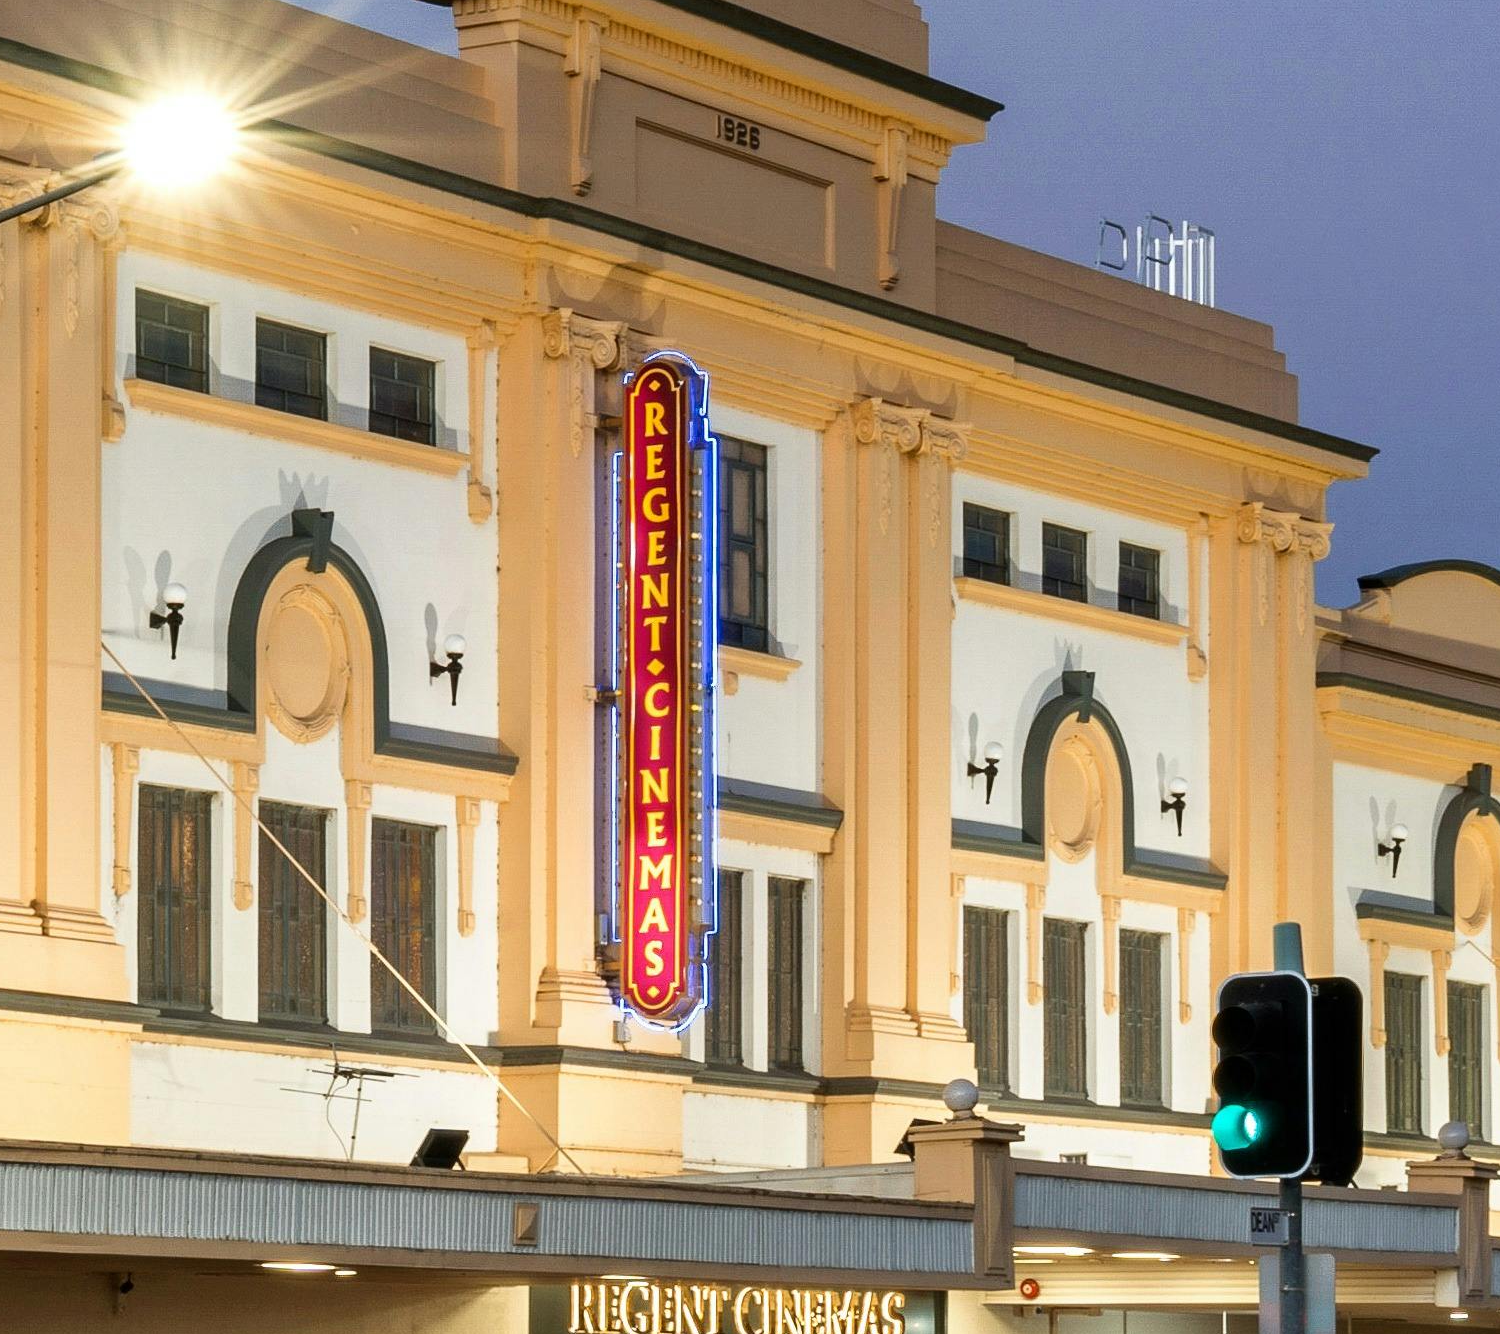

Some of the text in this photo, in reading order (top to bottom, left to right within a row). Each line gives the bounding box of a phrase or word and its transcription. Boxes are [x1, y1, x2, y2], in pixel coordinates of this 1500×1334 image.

[717, 115, 760, 150] 1926
[638, 402, 674, 977] REGENT CINEMAS
[1251, 1212, 1275, 1233] DEAN
